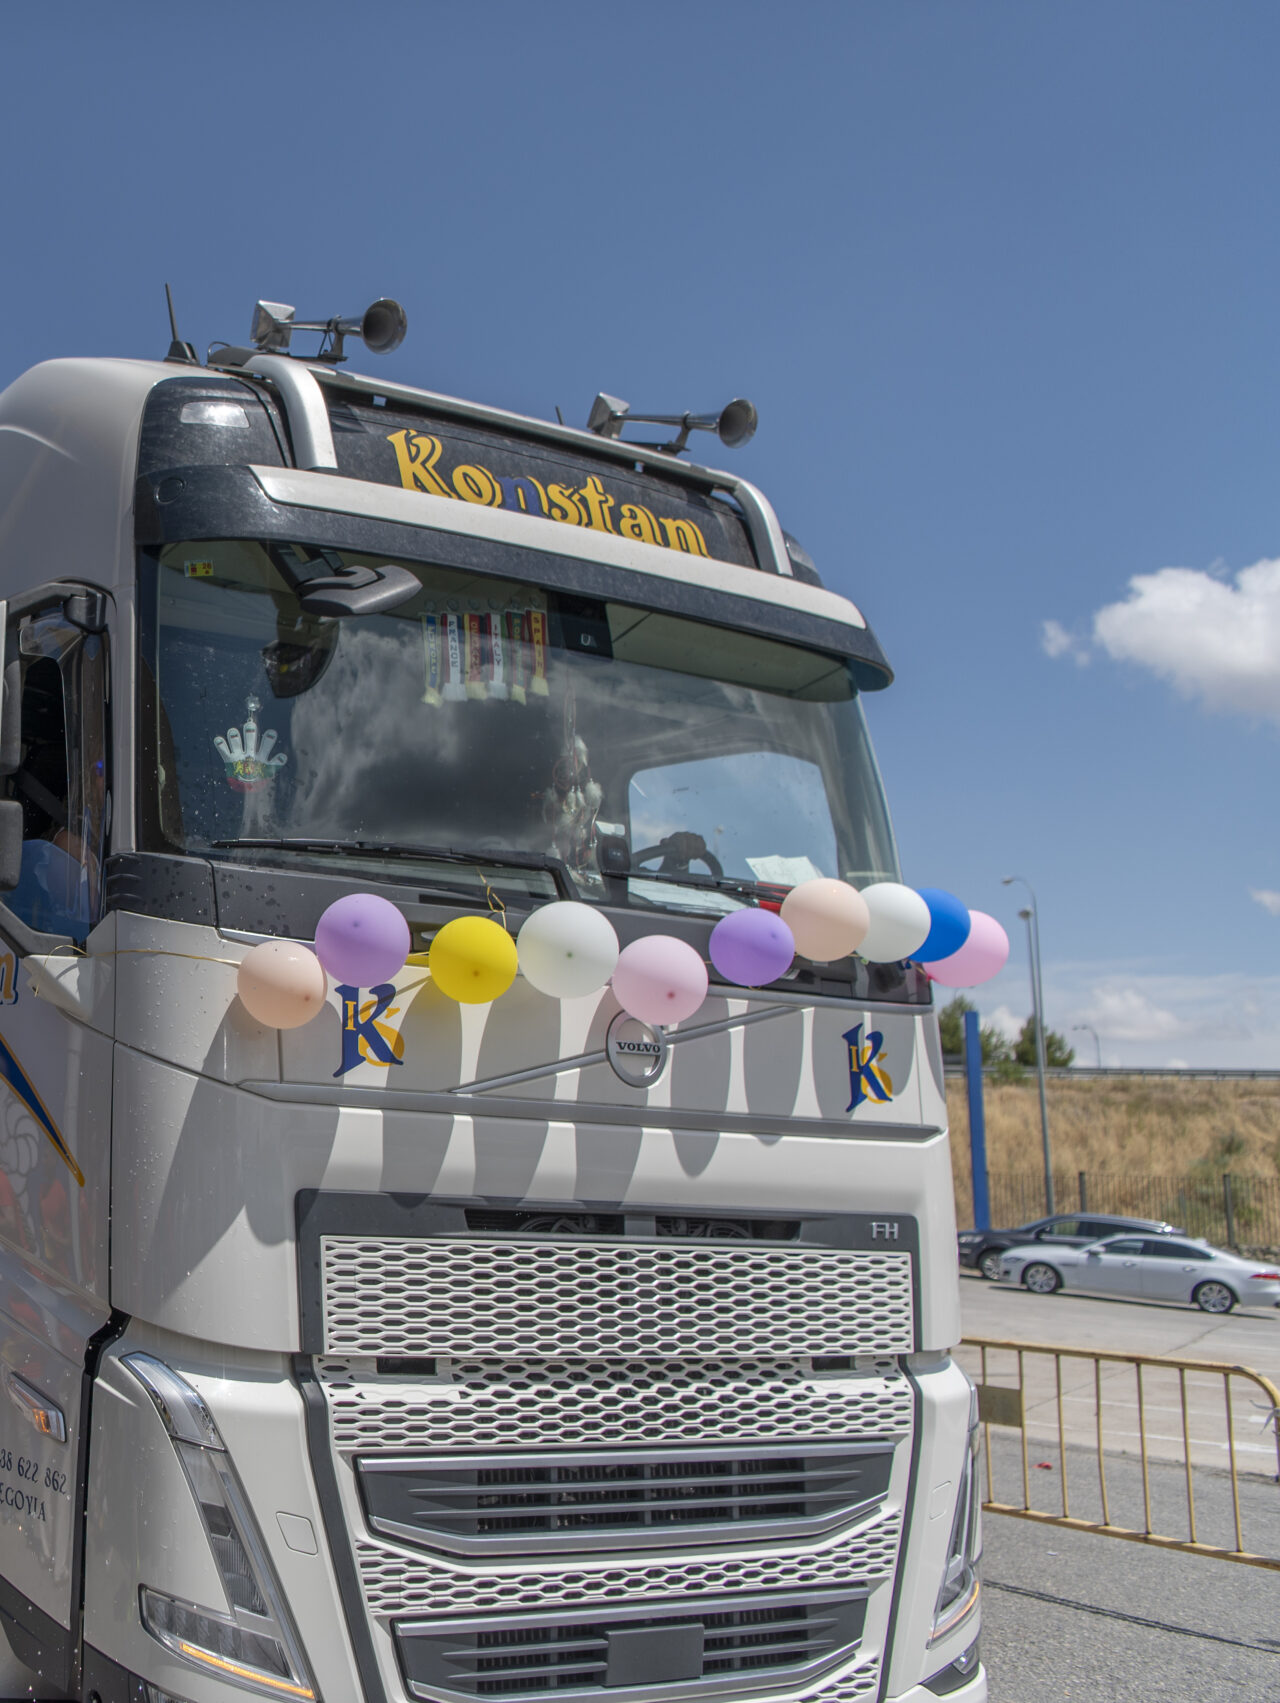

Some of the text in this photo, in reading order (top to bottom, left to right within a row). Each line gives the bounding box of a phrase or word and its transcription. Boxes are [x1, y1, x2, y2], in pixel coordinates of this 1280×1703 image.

[387, 429, 712, 559] Konstan
[492, 623, 502, 667] ITALY
[616, 1041, 661, 1053] VOLVO
[872, 1222, 899, 1239] FH
[18, 1456, 39, 1483] 622
[44, 1467, 67, 1495] 862
